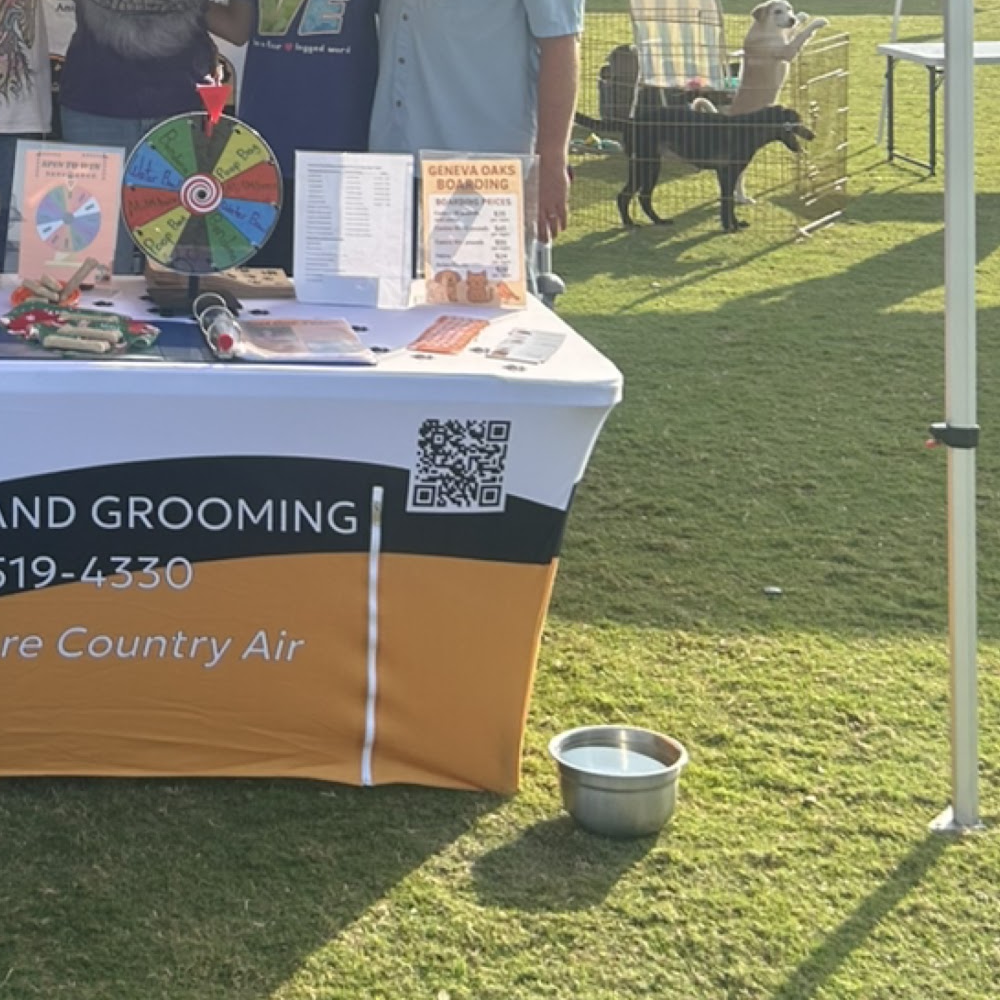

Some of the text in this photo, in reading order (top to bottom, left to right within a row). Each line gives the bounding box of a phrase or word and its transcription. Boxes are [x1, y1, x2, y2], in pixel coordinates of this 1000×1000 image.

[428, 165, 516, 176] GENEVA OAKS
[436, 178, 509, 191] BOARDING
[91, 495, 358, 534] GROOMING
[56, 626, 232, 668] Country
[241, 628, 306, 662] Air
